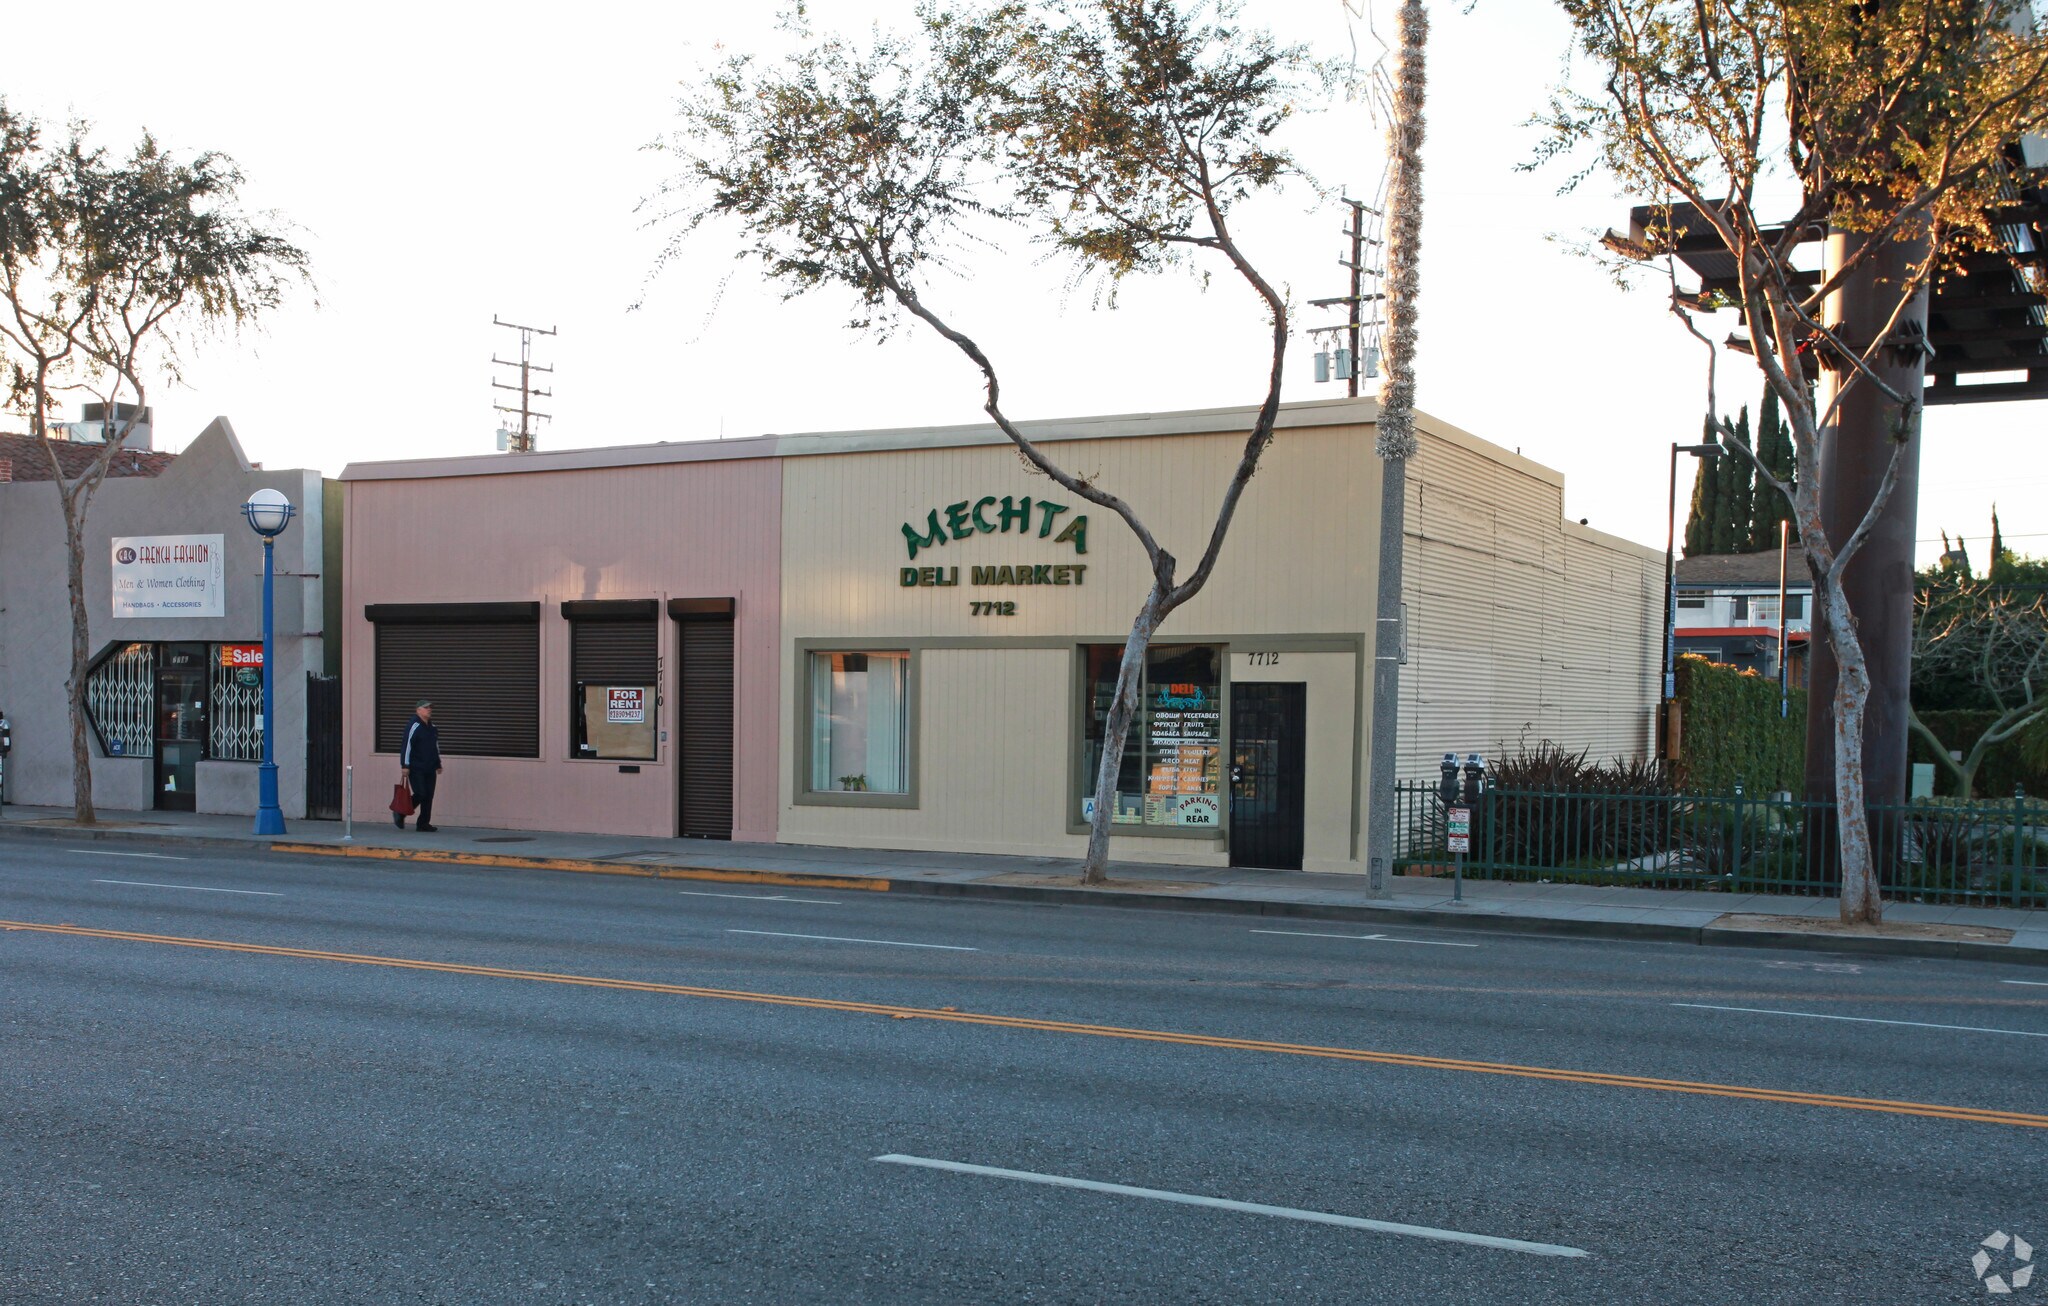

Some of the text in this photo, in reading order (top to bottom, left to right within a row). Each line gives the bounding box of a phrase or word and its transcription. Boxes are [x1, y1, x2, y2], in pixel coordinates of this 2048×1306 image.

[901, 495, 1087, 560] MECHTA
[139, 544, 209, 564] FRENCH FASHION
[900, 564, 1087, 587] DELI MARKET
[119, 575, 206, 592] Men & Women Clothing
[969, 601, 1015, 616] 7712
[233, 649, 264, 663] Sale
[1248, 652, 1279, 666] 7712
[237, 674, 257, 682] OPEN
[613, 690, 637, 699] FOR
[1170, 684, 1194, 694] DELI
[610, 699, 641, 709] RENT
[1085, 802, 1094, 814] A
[1180, 796, 1217, 811] PARKING
[1186, 815, 1210, 823] REAR
